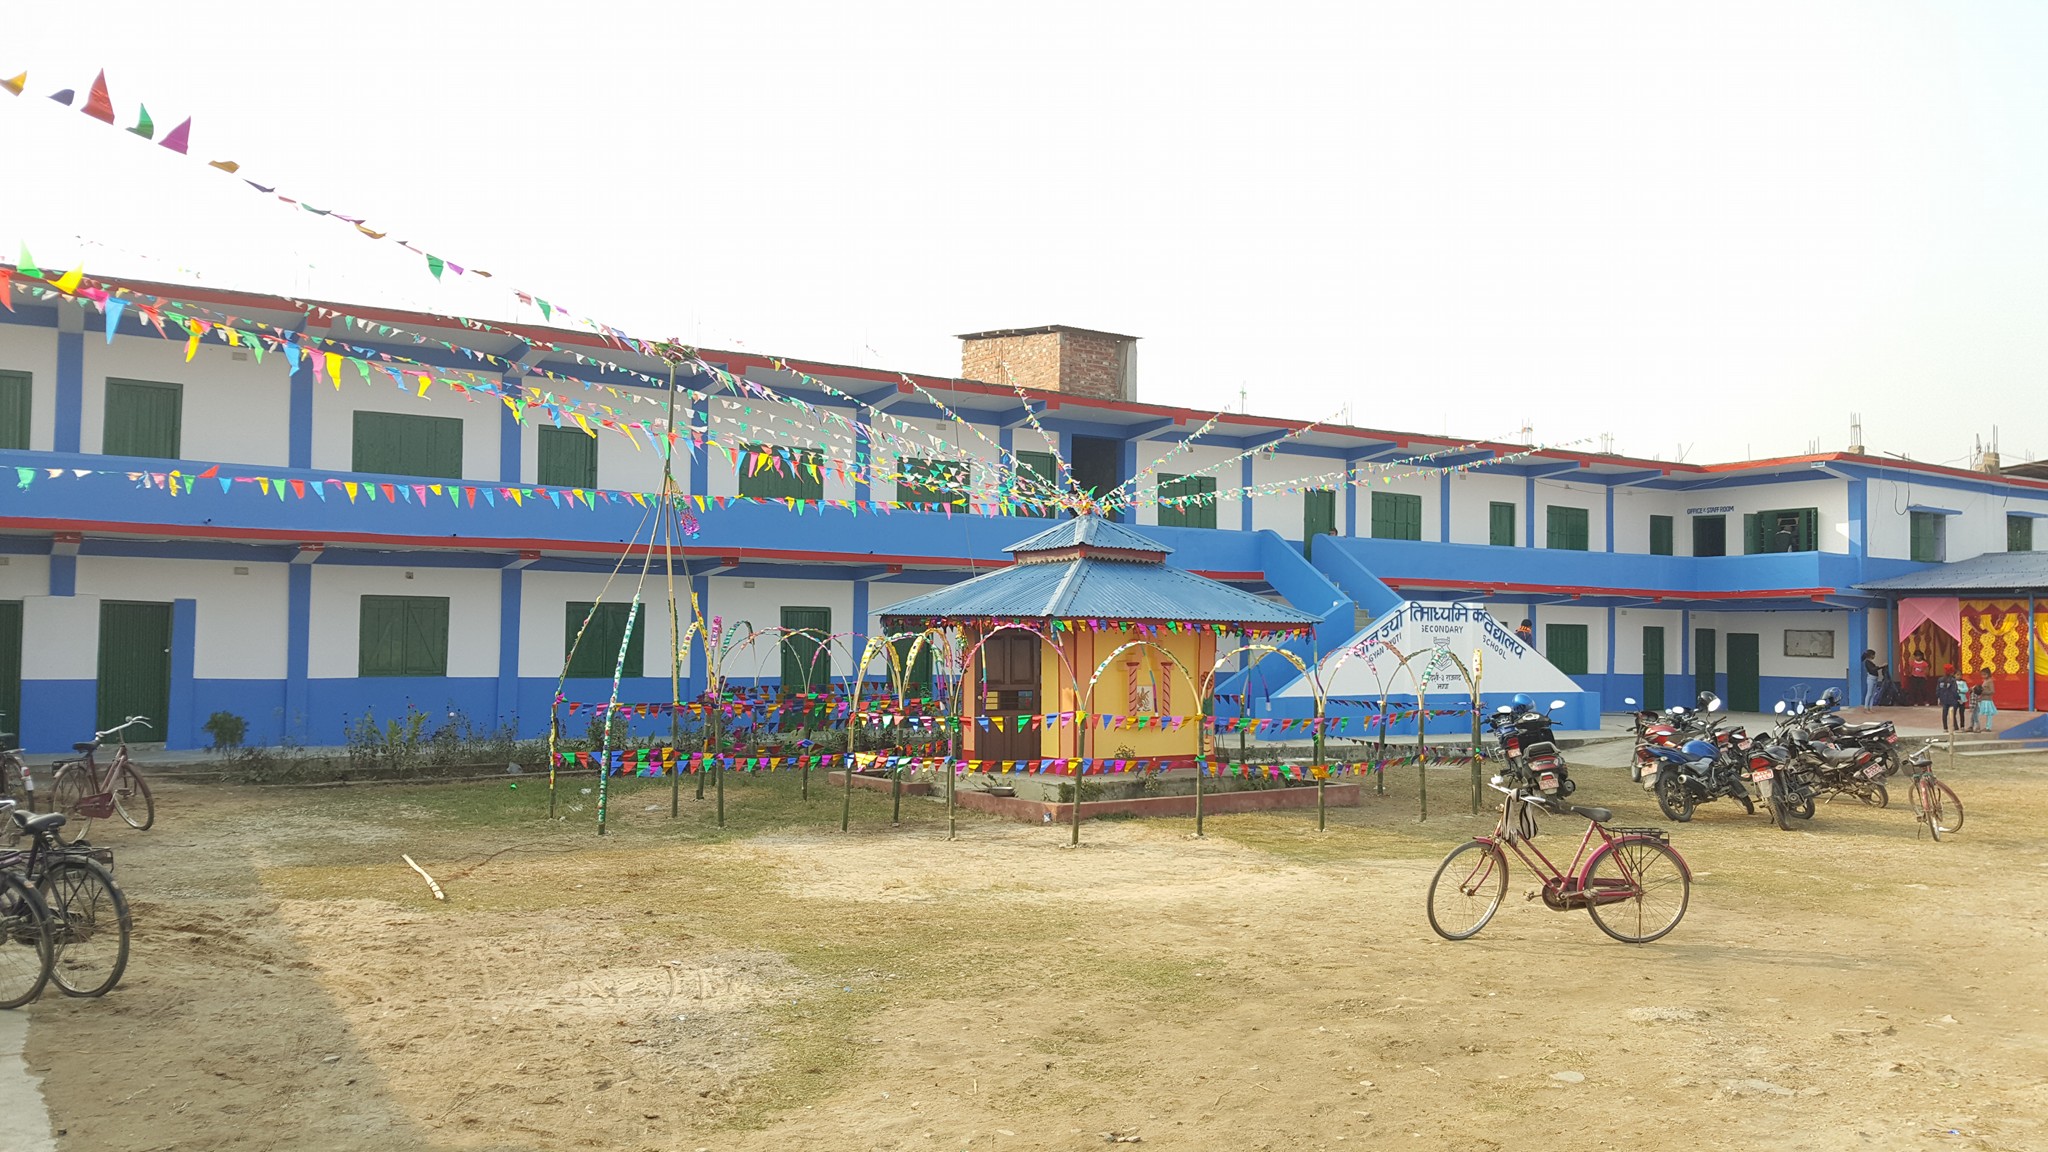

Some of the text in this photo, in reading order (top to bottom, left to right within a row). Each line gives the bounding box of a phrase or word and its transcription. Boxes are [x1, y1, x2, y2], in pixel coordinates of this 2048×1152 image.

[1368, 624, 1507, 662] GYAN YOTI SECONDARY SCHOOL
[1482, 611, 1527, 660] विद्यालय
